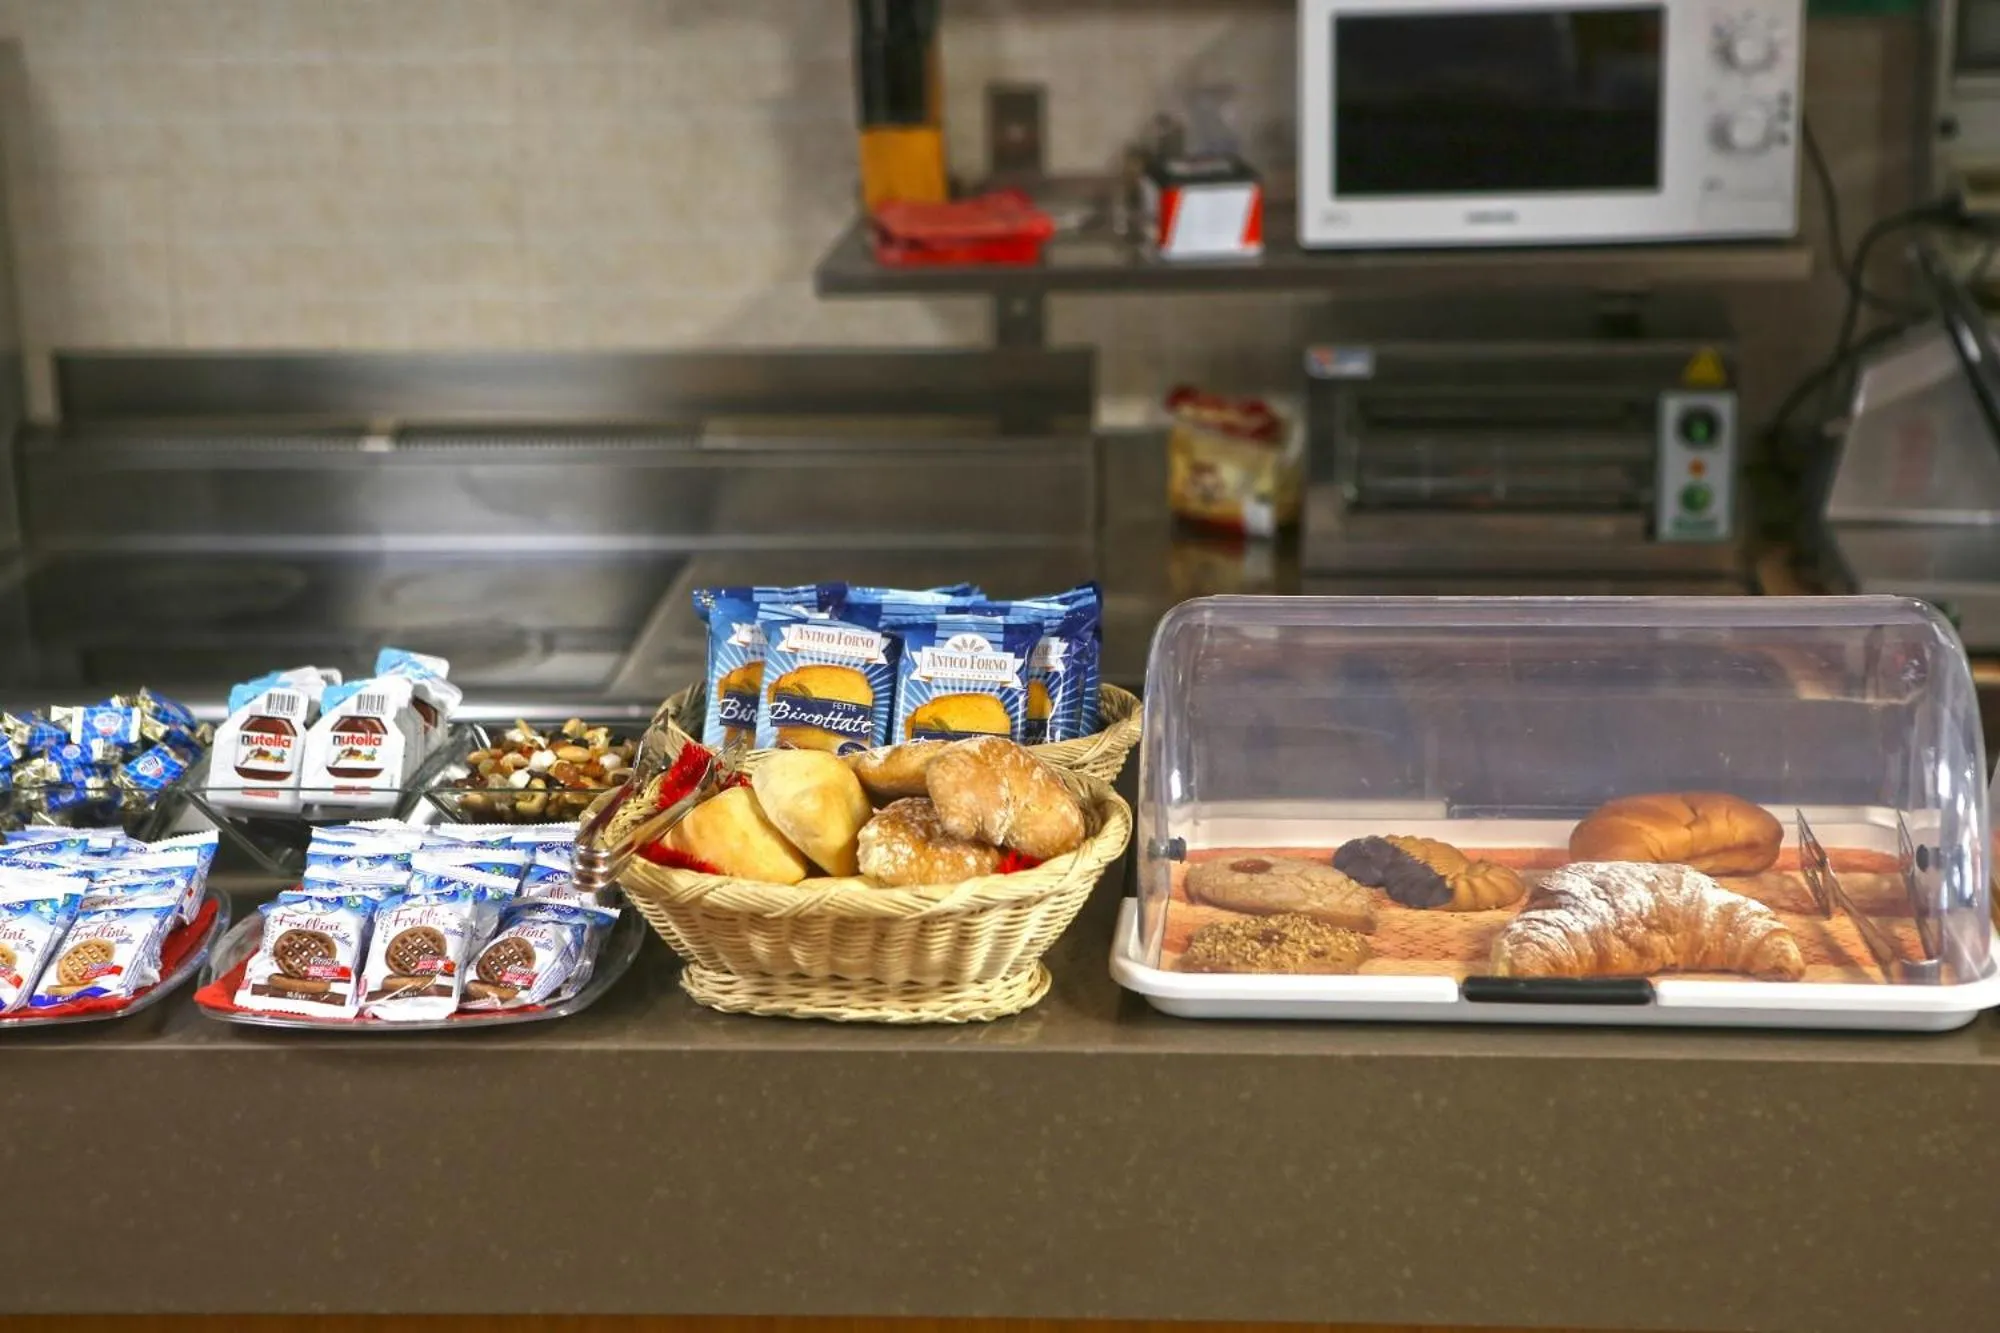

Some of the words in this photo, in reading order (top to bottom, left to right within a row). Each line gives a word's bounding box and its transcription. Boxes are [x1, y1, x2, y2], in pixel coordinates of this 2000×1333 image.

[832, 701, 858, 713] FETTE
[768, 700, 875, 733] Biscottate
[241, 731, 291, 748] nutella
[333, 730, 383, 747] nutella
[275, 913, 342, 931] Frollini
[72, 923, 127, 941] Frollini
